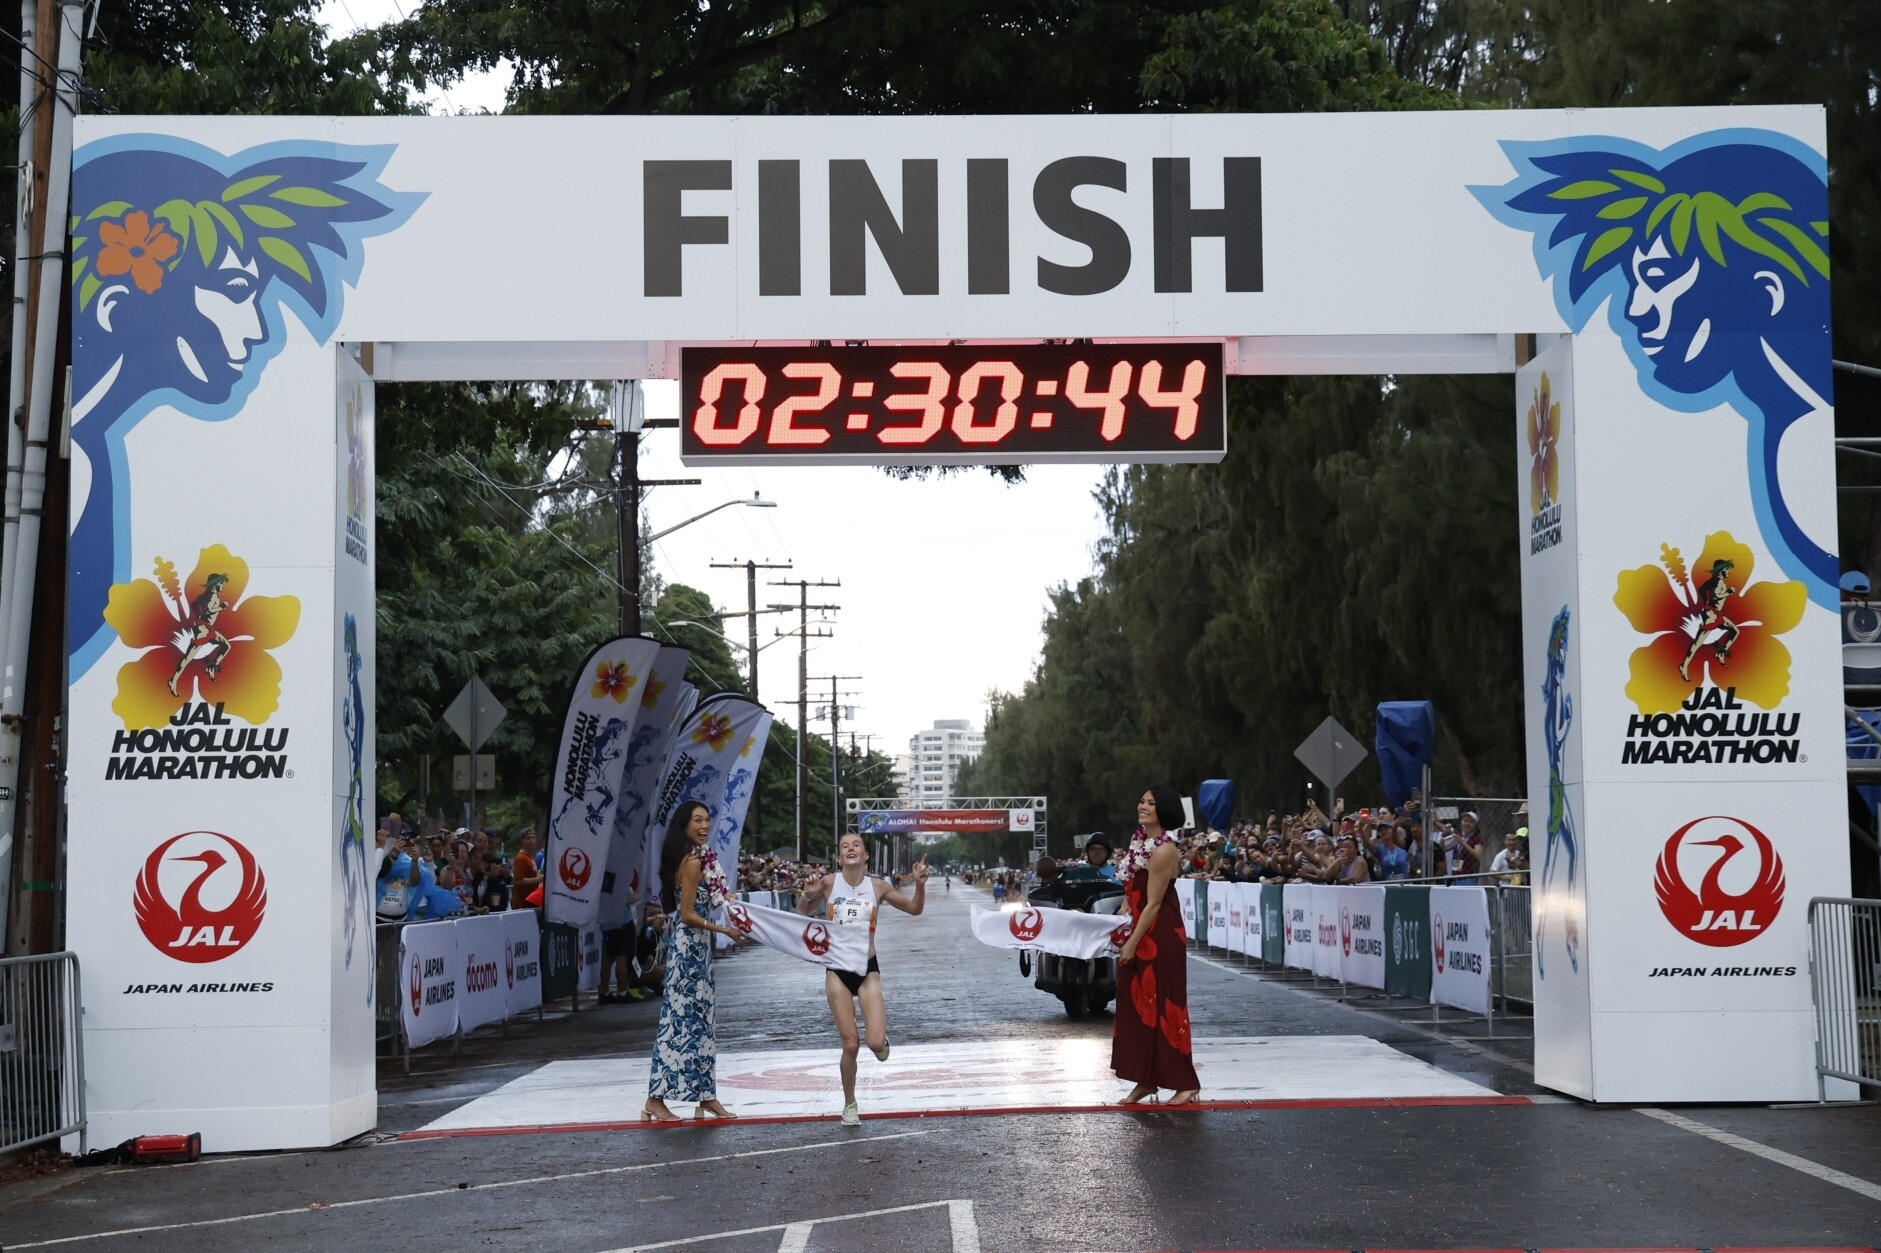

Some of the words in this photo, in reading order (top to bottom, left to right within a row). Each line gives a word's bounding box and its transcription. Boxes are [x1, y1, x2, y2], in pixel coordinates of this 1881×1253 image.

[643, 155, 1264, 297] FINISH
[693, 359, 1207, 445] 02:30:44
[1531, 504, 1562, 535] HONOLULU
[1682, 686, 1743, 711] JAL
[170, 701, 232, 726] JAL
[1626, 712, 1801, 738] HONOLULU
[111, 728, 289, 754] HONOLULU
[563, 710, 589, 796] HONOLULU
[661, 751, 688, 801] HONOLULU
[888, 818, 917, 826] ALOHA!
[919, 817, 953, 825] Honolulu
[954, 817, 1004, 826] Marathoners!
[566, 877, 582, 887] JAL
[847, 909, 857, 917] F5
[1352, 913, 1371, 931] JAPAN
[1690, 909, 1762, 931] JAL
[168, 925, 240, 947] JAL
[1446, 922, 1468, 942] JAPAN
[514, 940, 528, 958] JAPAN
[1354, 938, 1382, 957] AIRLINES
[424, 957, 444, 978] JAPAN
[516, 962, 538, 981] AIRLINES
[1449, 950, 1482, 975] AIRLINES
[1648, 967, 1707, 977] JAPAN
[1710, 966, 1797, 977] AIRLINES
[466, 954, 498, 994] docomo
[123, 983, 183, 994] JAPAN
[186, 982, 274, 993] AIRLINES
[425, 981, 455, 1006] AIRLINES
